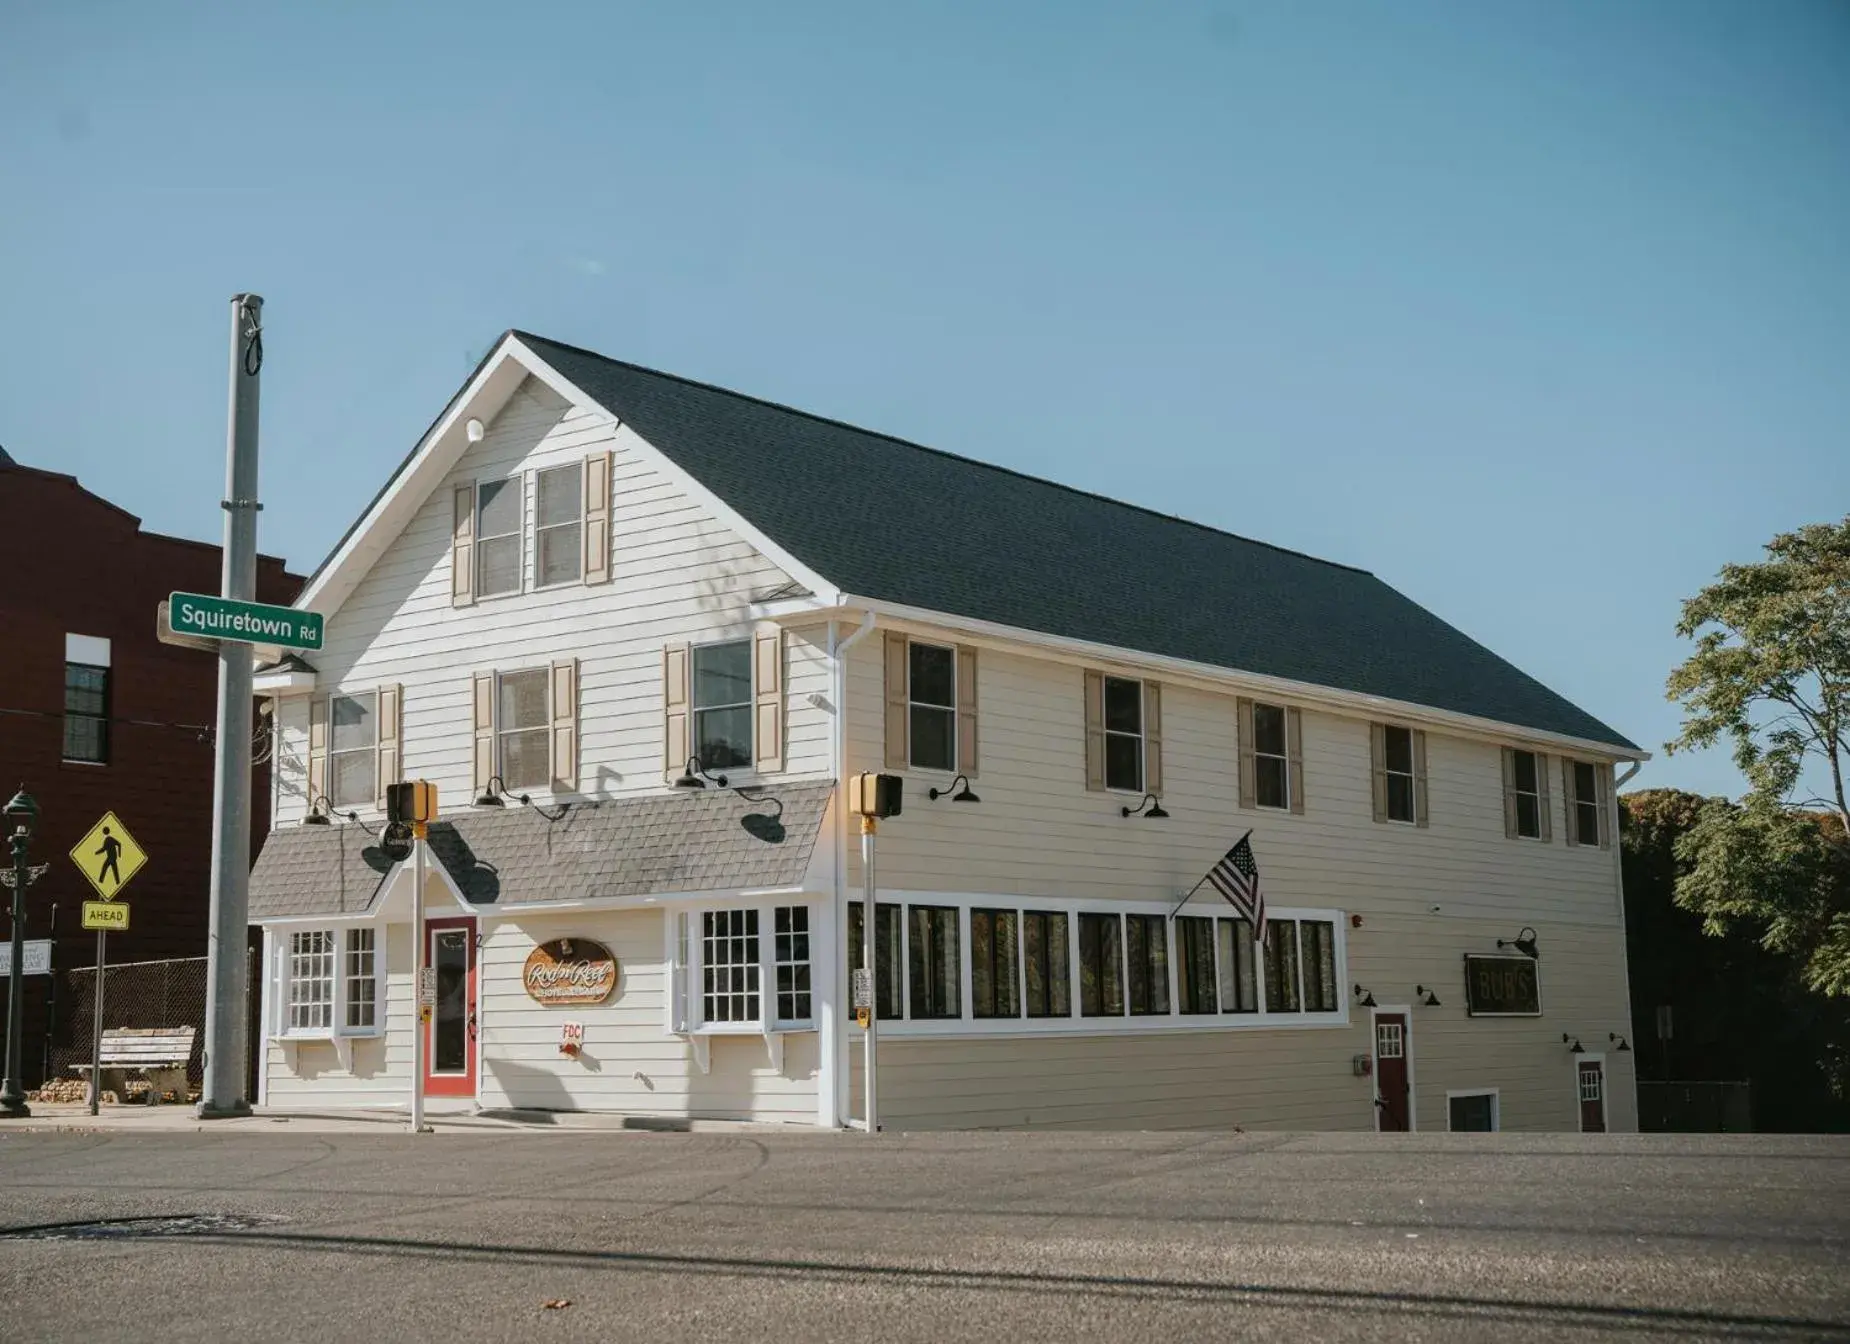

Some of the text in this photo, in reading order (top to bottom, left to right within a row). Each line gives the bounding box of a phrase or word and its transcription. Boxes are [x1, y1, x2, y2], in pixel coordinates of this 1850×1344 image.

[181, 603, 316, 641] Squiretown Rd
[90, 910, 123, 921] AHEAD
[527, 960, 563, 988] Rod
[571, 959, 613, 987] Reel
[563, 1024, 581, 1039] FDC
